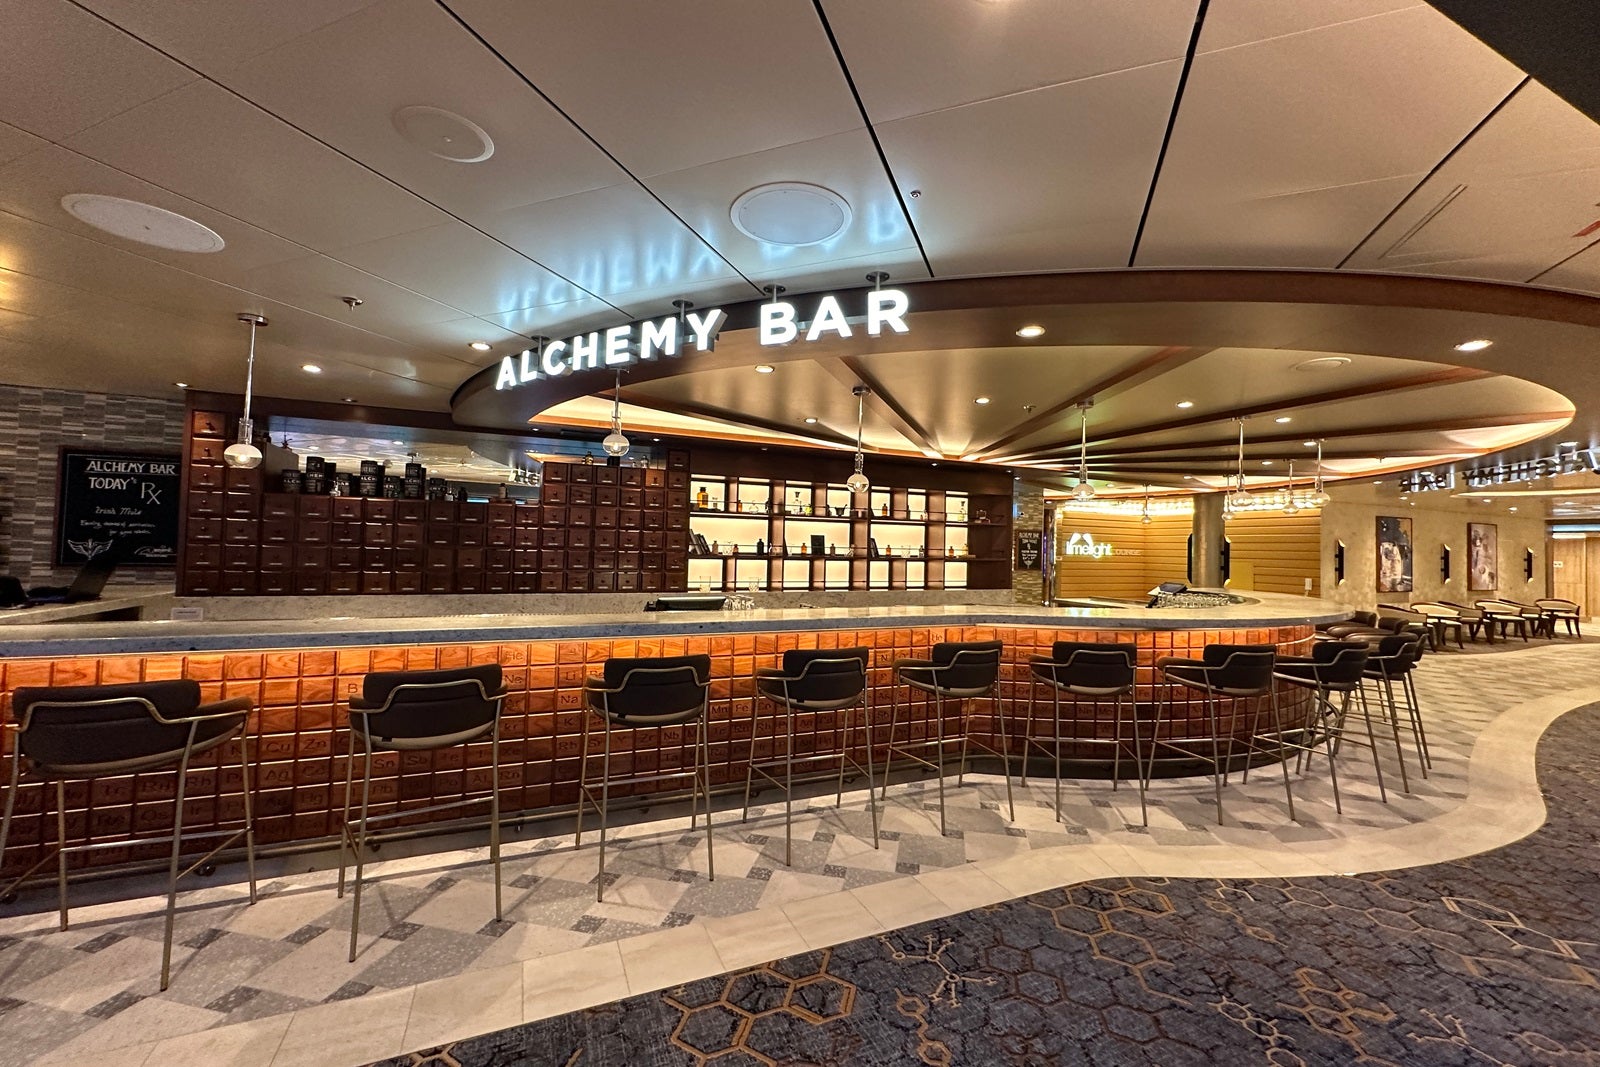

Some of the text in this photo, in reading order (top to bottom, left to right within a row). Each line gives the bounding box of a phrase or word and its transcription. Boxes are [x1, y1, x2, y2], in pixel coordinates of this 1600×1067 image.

[496, 289, 910, 391] ALCHEMY BAR
[86, 460, 176, 475] ALCHEMY BAR
[347, 683, 358, 694] B
[560, 695, 579, 704] Na
[711, 705, 728, 714] Mn
[735, 703, 749, 712] Fe
[564, 718, 573, 727] K
[266, 742, 290, 753] Cu
[304, 738, 326, 750] Zn
[374, 759, 396, 770] Sn
